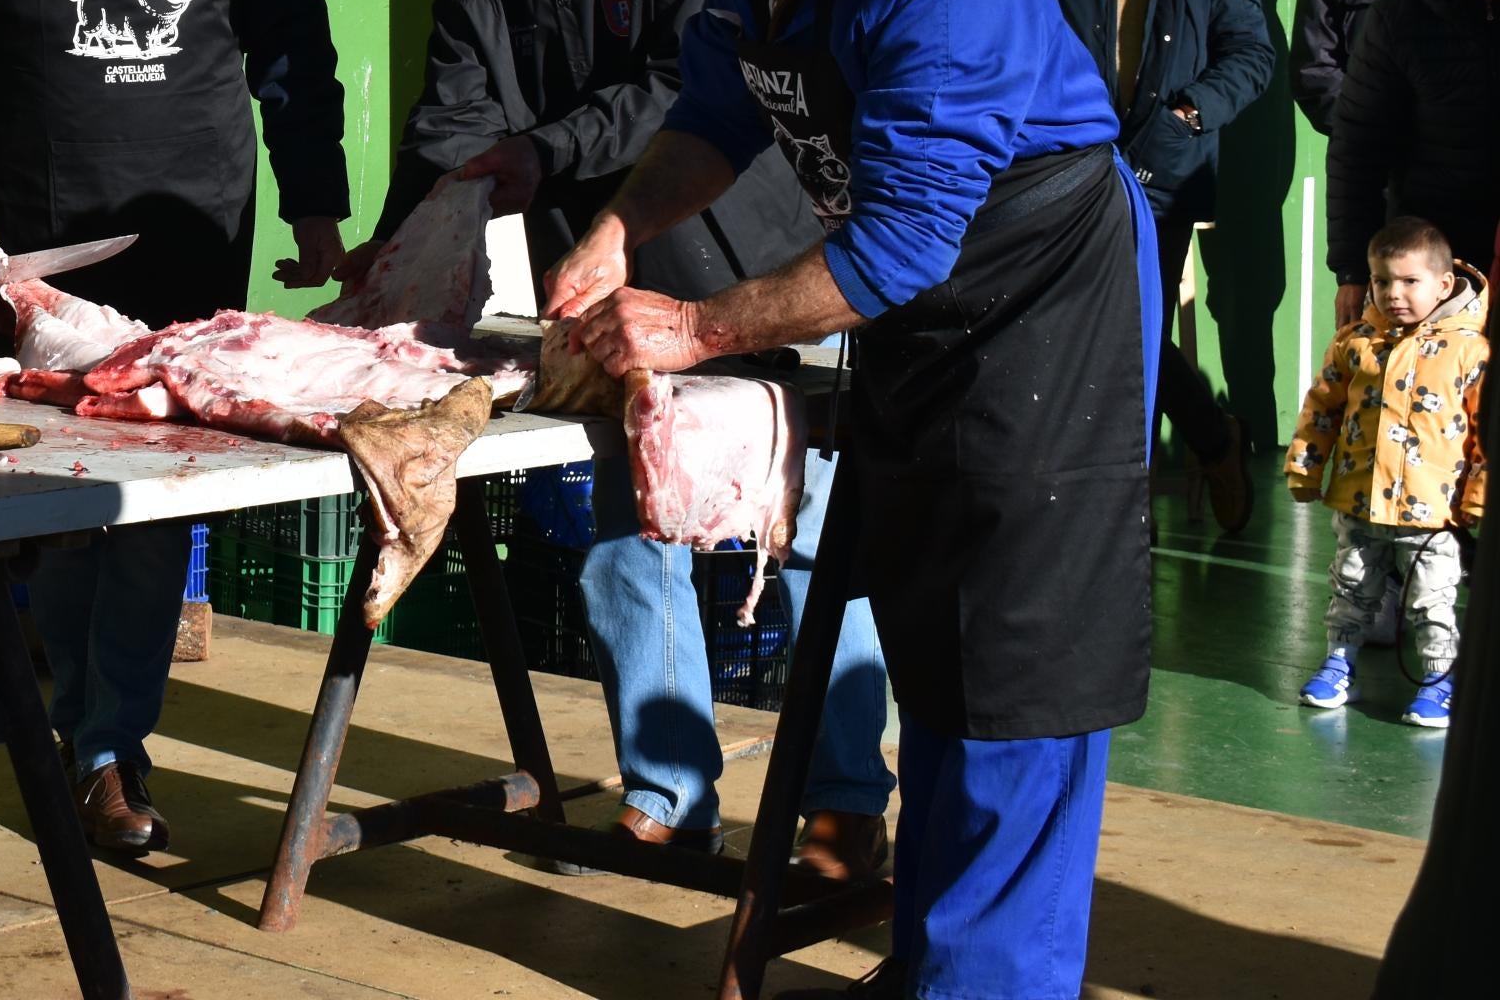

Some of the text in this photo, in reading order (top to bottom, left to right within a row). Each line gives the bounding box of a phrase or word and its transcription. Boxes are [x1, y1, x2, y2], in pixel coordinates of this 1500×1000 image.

[106, 63, 165, 75] CASTELLANOS
[104, 72, 167, 84] DE VILLIQUERA
